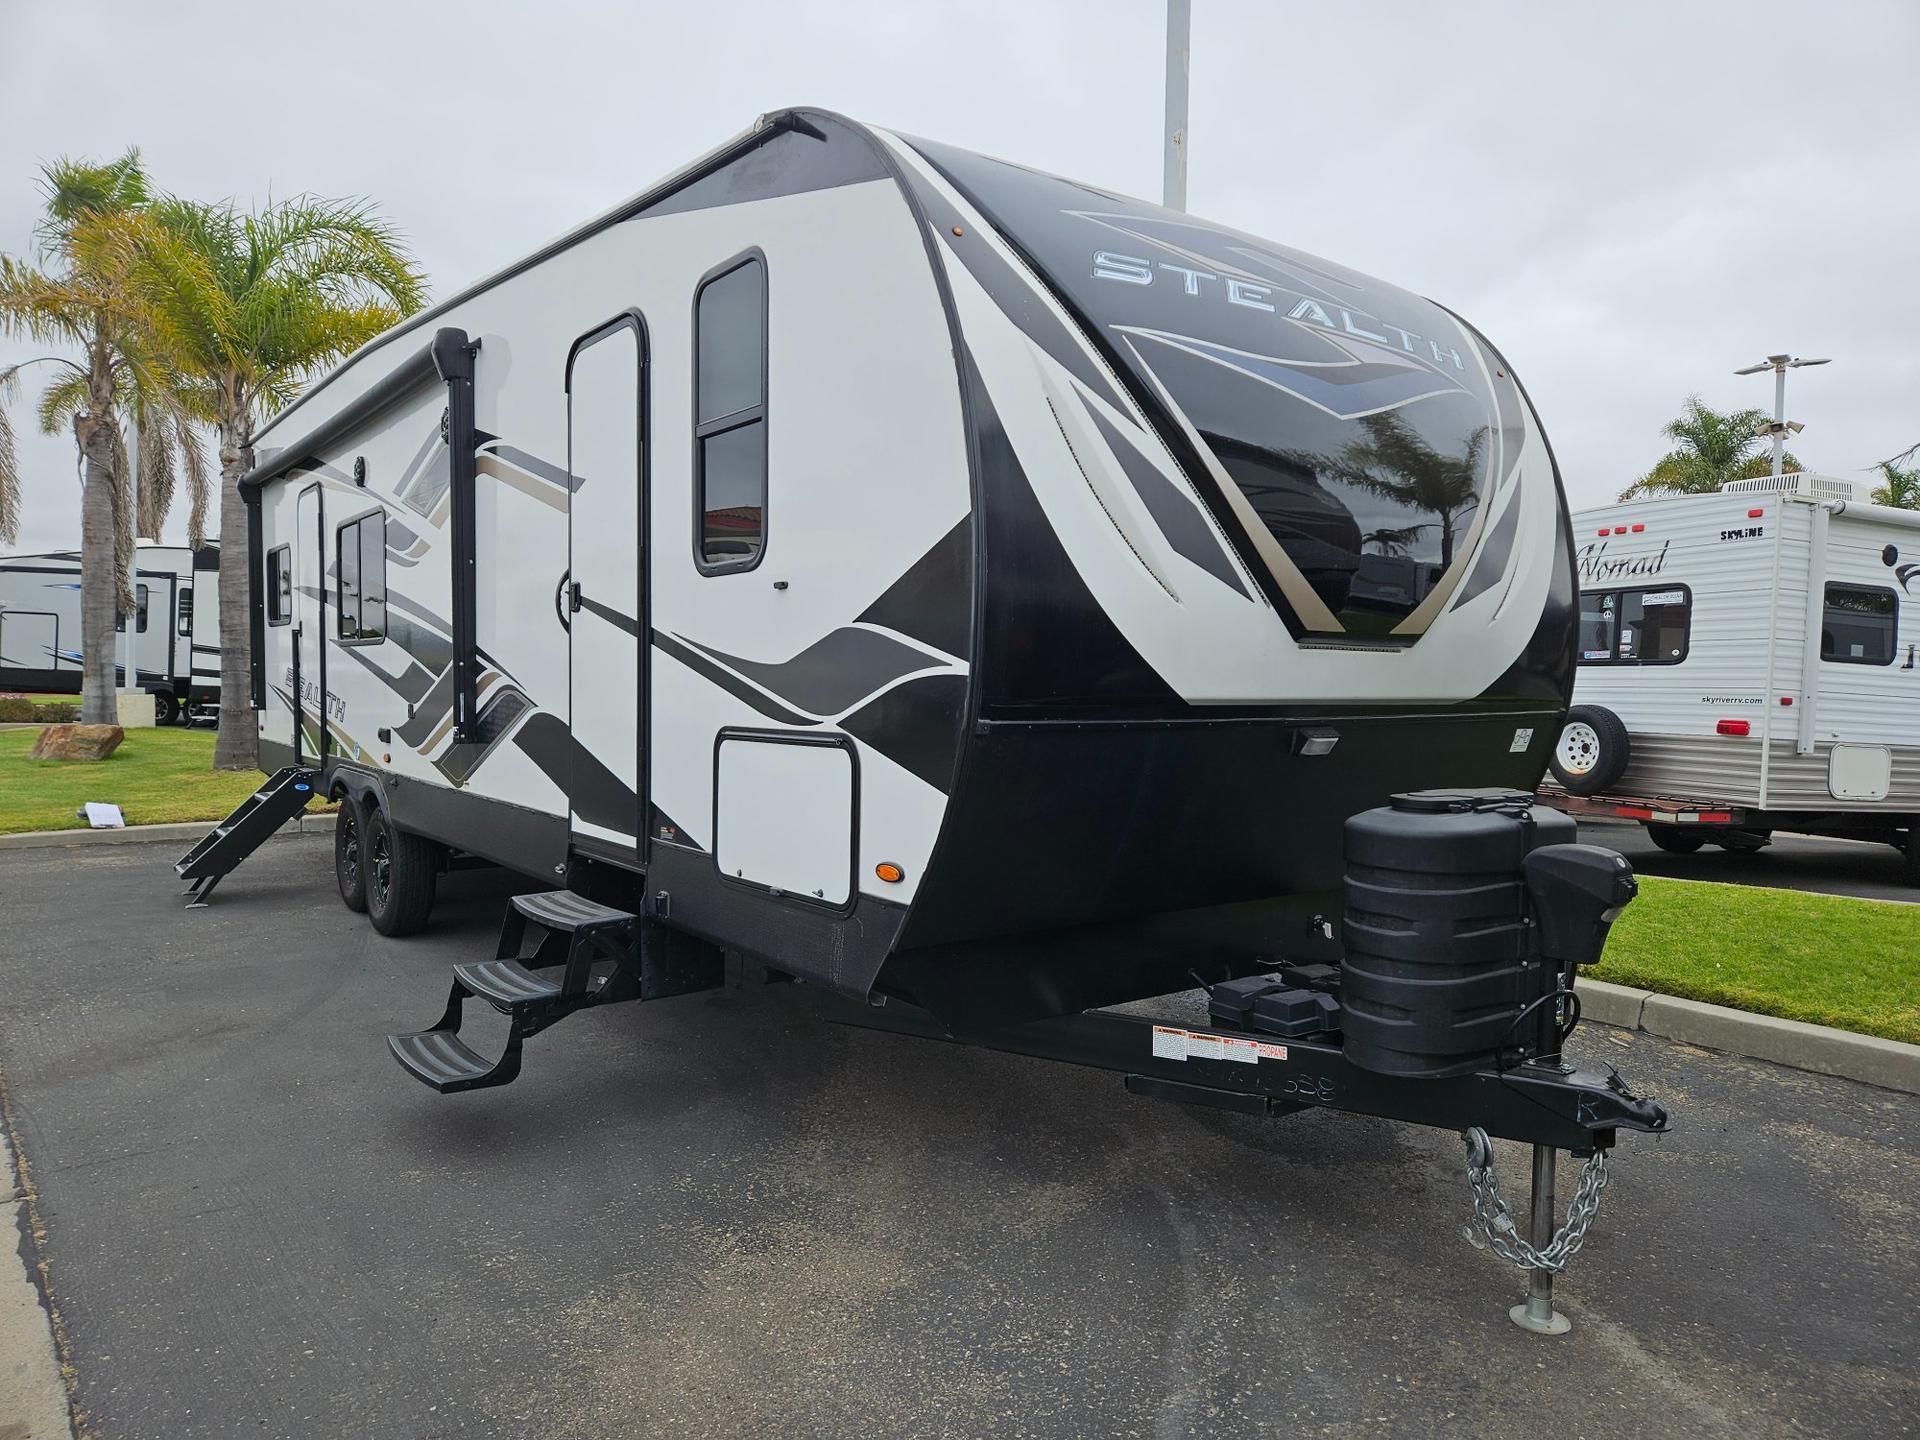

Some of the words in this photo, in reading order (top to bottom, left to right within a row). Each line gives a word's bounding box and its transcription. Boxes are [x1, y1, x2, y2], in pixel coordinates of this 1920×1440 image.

[1090, 248, 1466, 371] STEALTH
[1576, 540, 1669, 582] Nomad
[1702, 696, 1763, 705] skyriverrv.com
[1259, 1044, 1287, 1059] PROPANE
